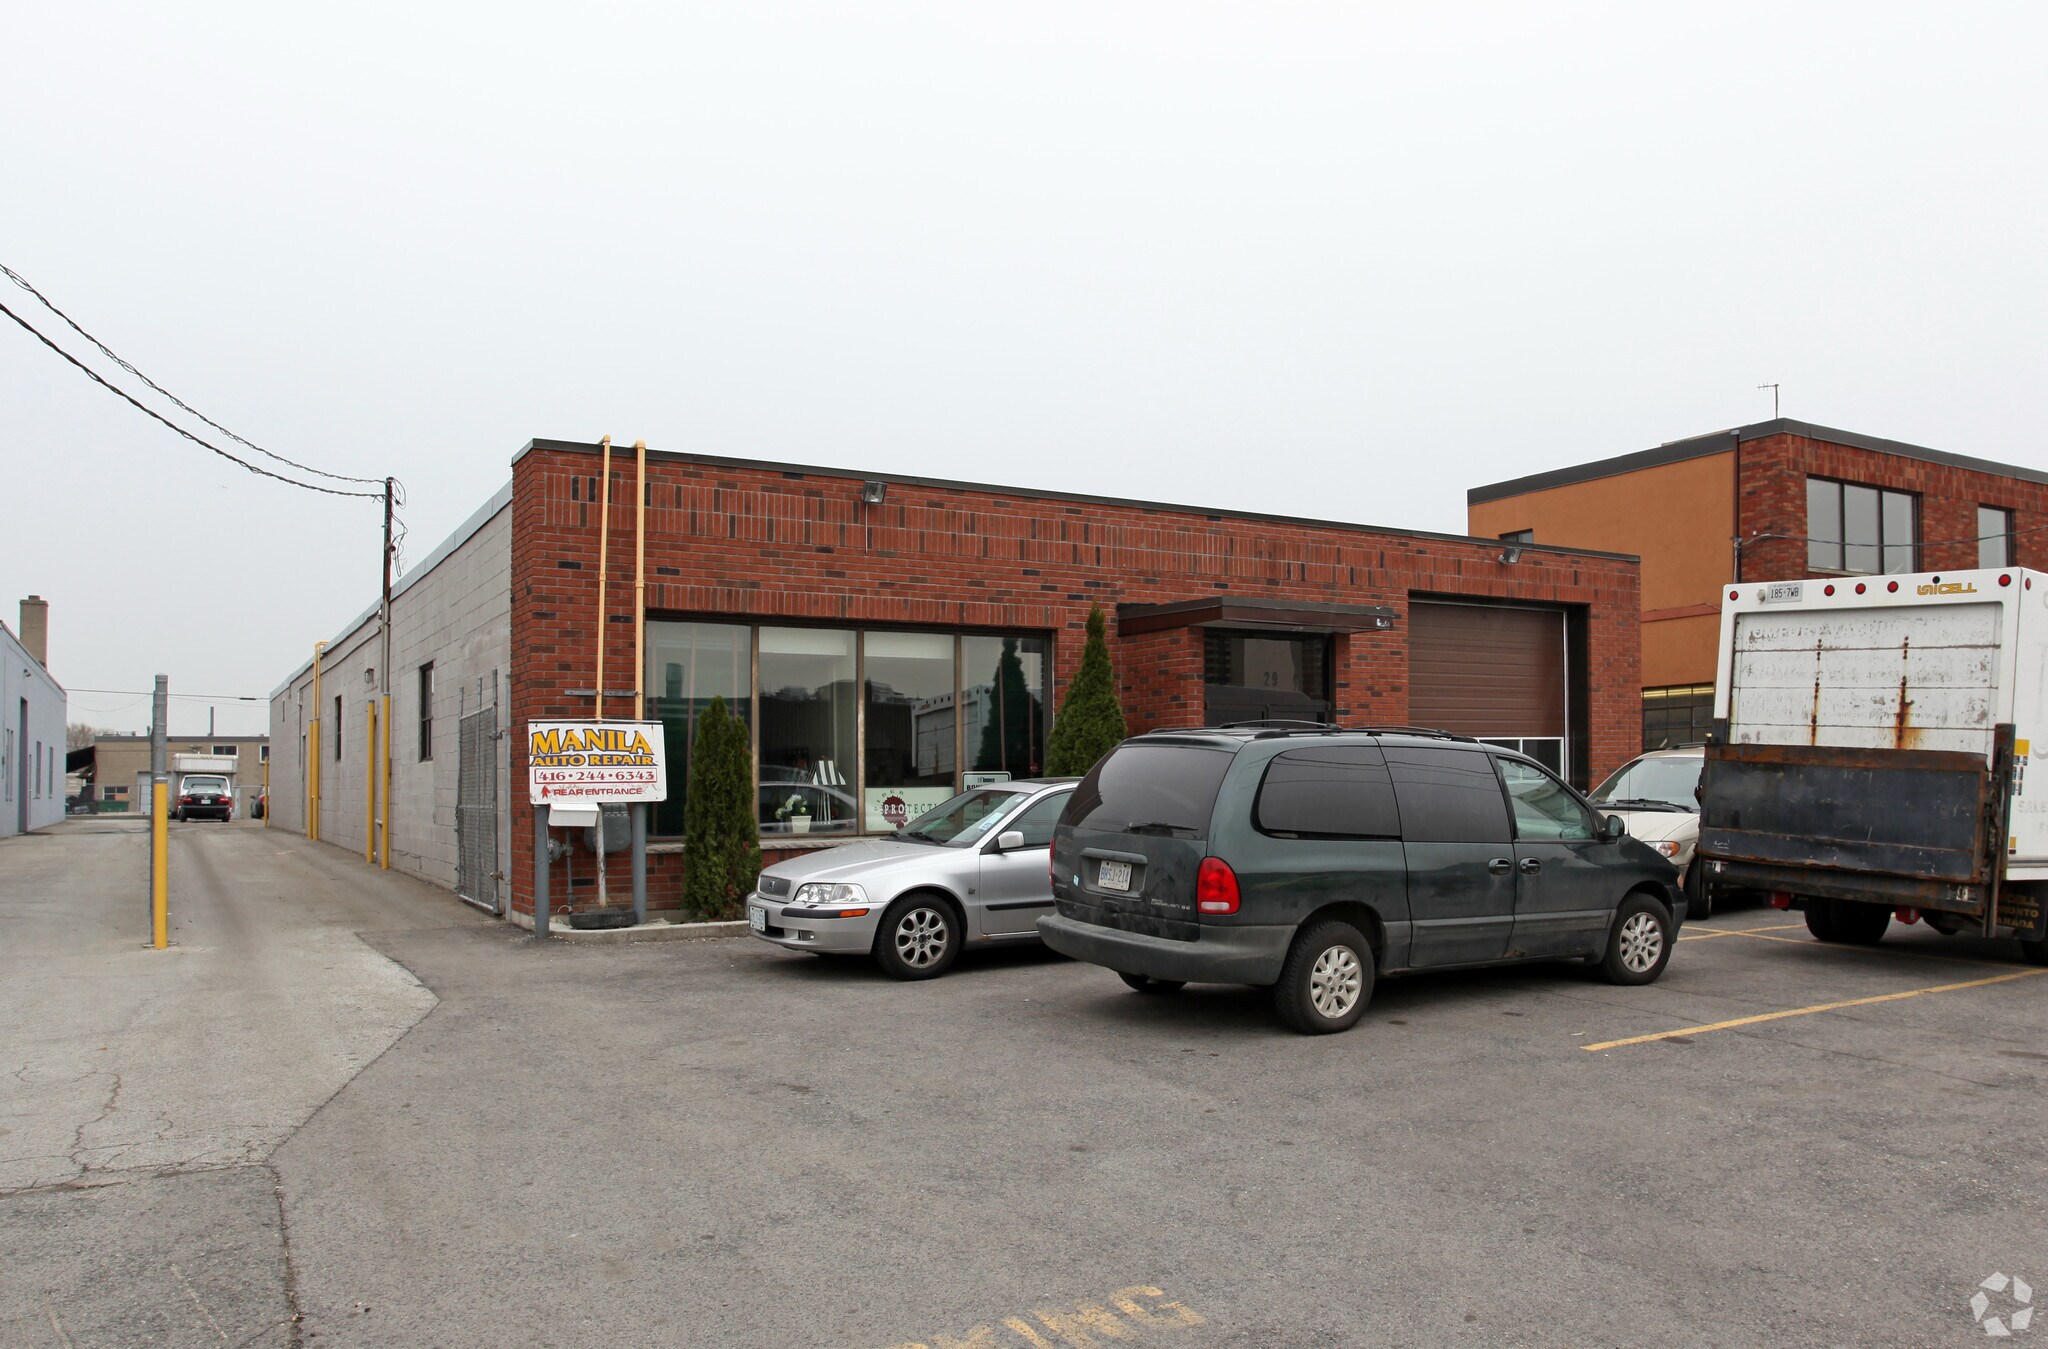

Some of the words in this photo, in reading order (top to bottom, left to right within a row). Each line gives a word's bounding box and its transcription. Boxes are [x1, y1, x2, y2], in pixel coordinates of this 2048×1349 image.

[1263, 671, 1278, 687] 29
[530, 728, 655, 756] MANILA
[530, 754, 586, 767] AUTO
[588, 754, 658, 767] REPAIR
[553, 788, 583, 796] REAR
[585, 787, 643, 796] ENTRANCE
